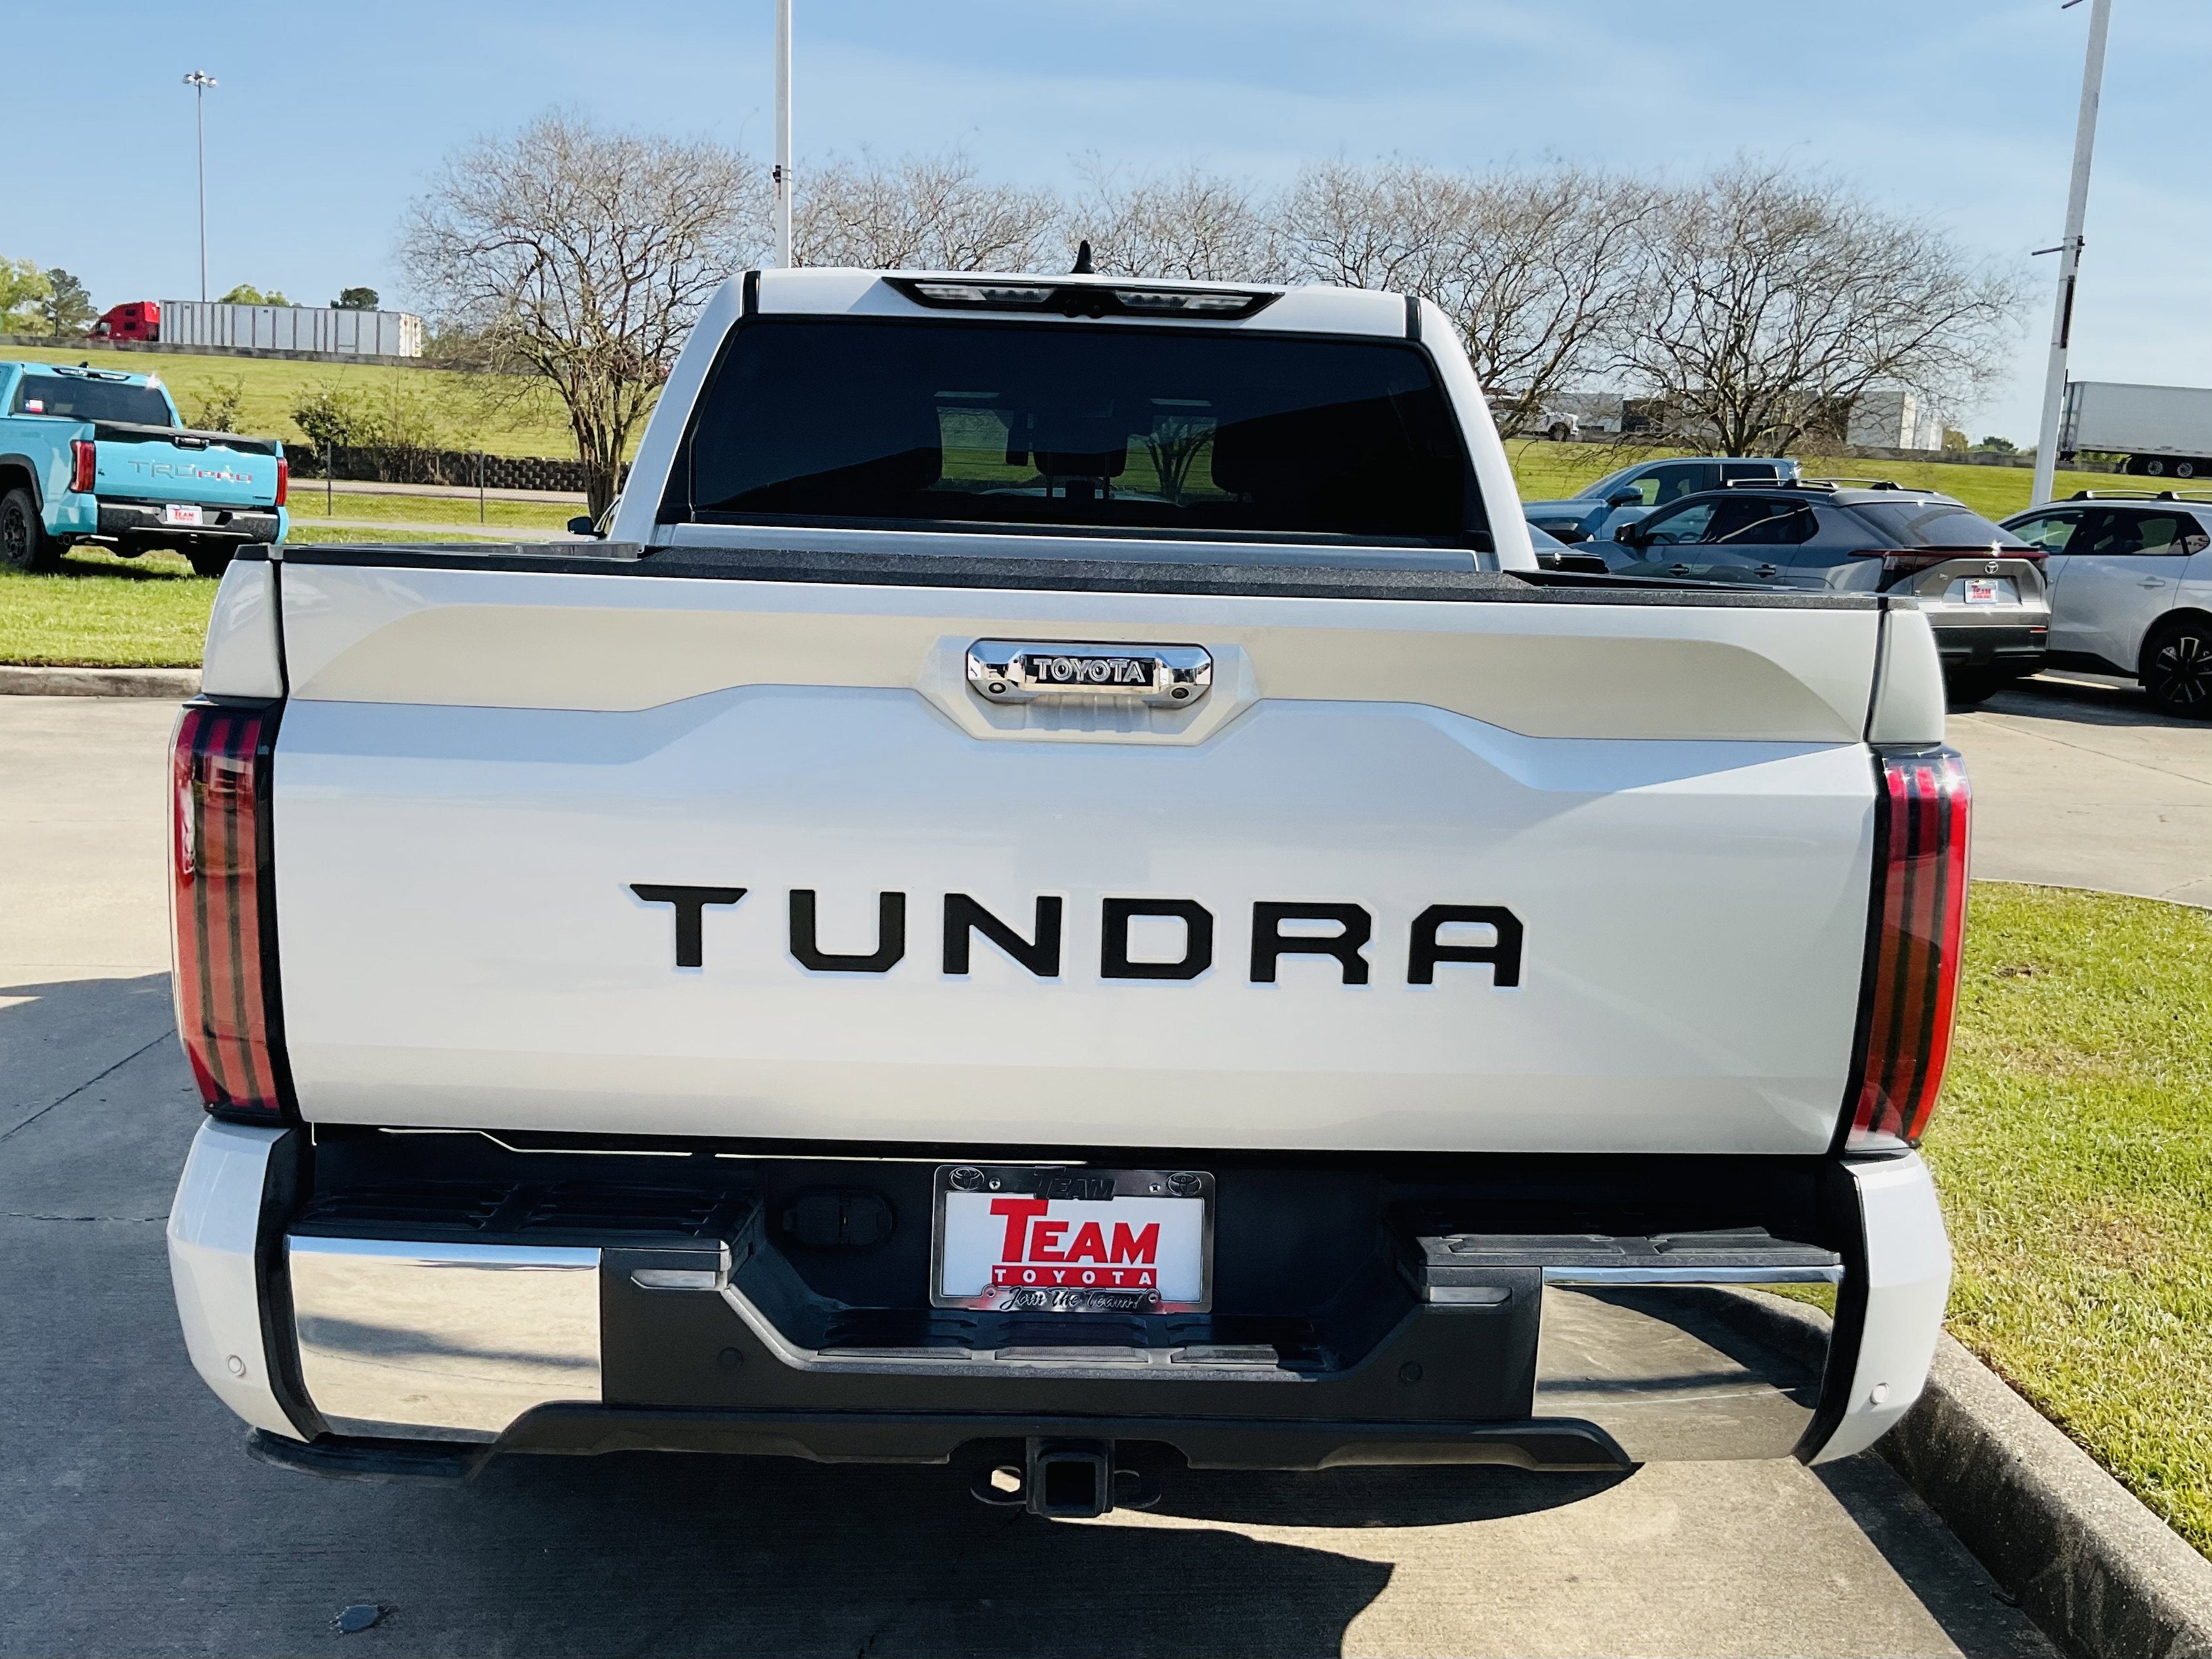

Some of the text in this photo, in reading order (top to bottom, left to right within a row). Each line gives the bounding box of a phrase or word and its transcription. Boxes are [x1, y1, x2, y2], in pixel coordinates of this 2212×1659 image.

[127, 460, 196, 479] TRD
[1971, 585, 1991, 595] TEAM
[1034, 657, 1145, 683] TOYOTA
[630, 884, 1524, 987] TUNDRA
[1034, 1166, 1116, 1200] TEAM
[990, 1198, 1160, 1265] TEAM
[994, 1268, 1152, 1285] TOYOTA
[1000, 1287, 1045, 1311] Join
[1047, 1287, 1081, 1309] The
